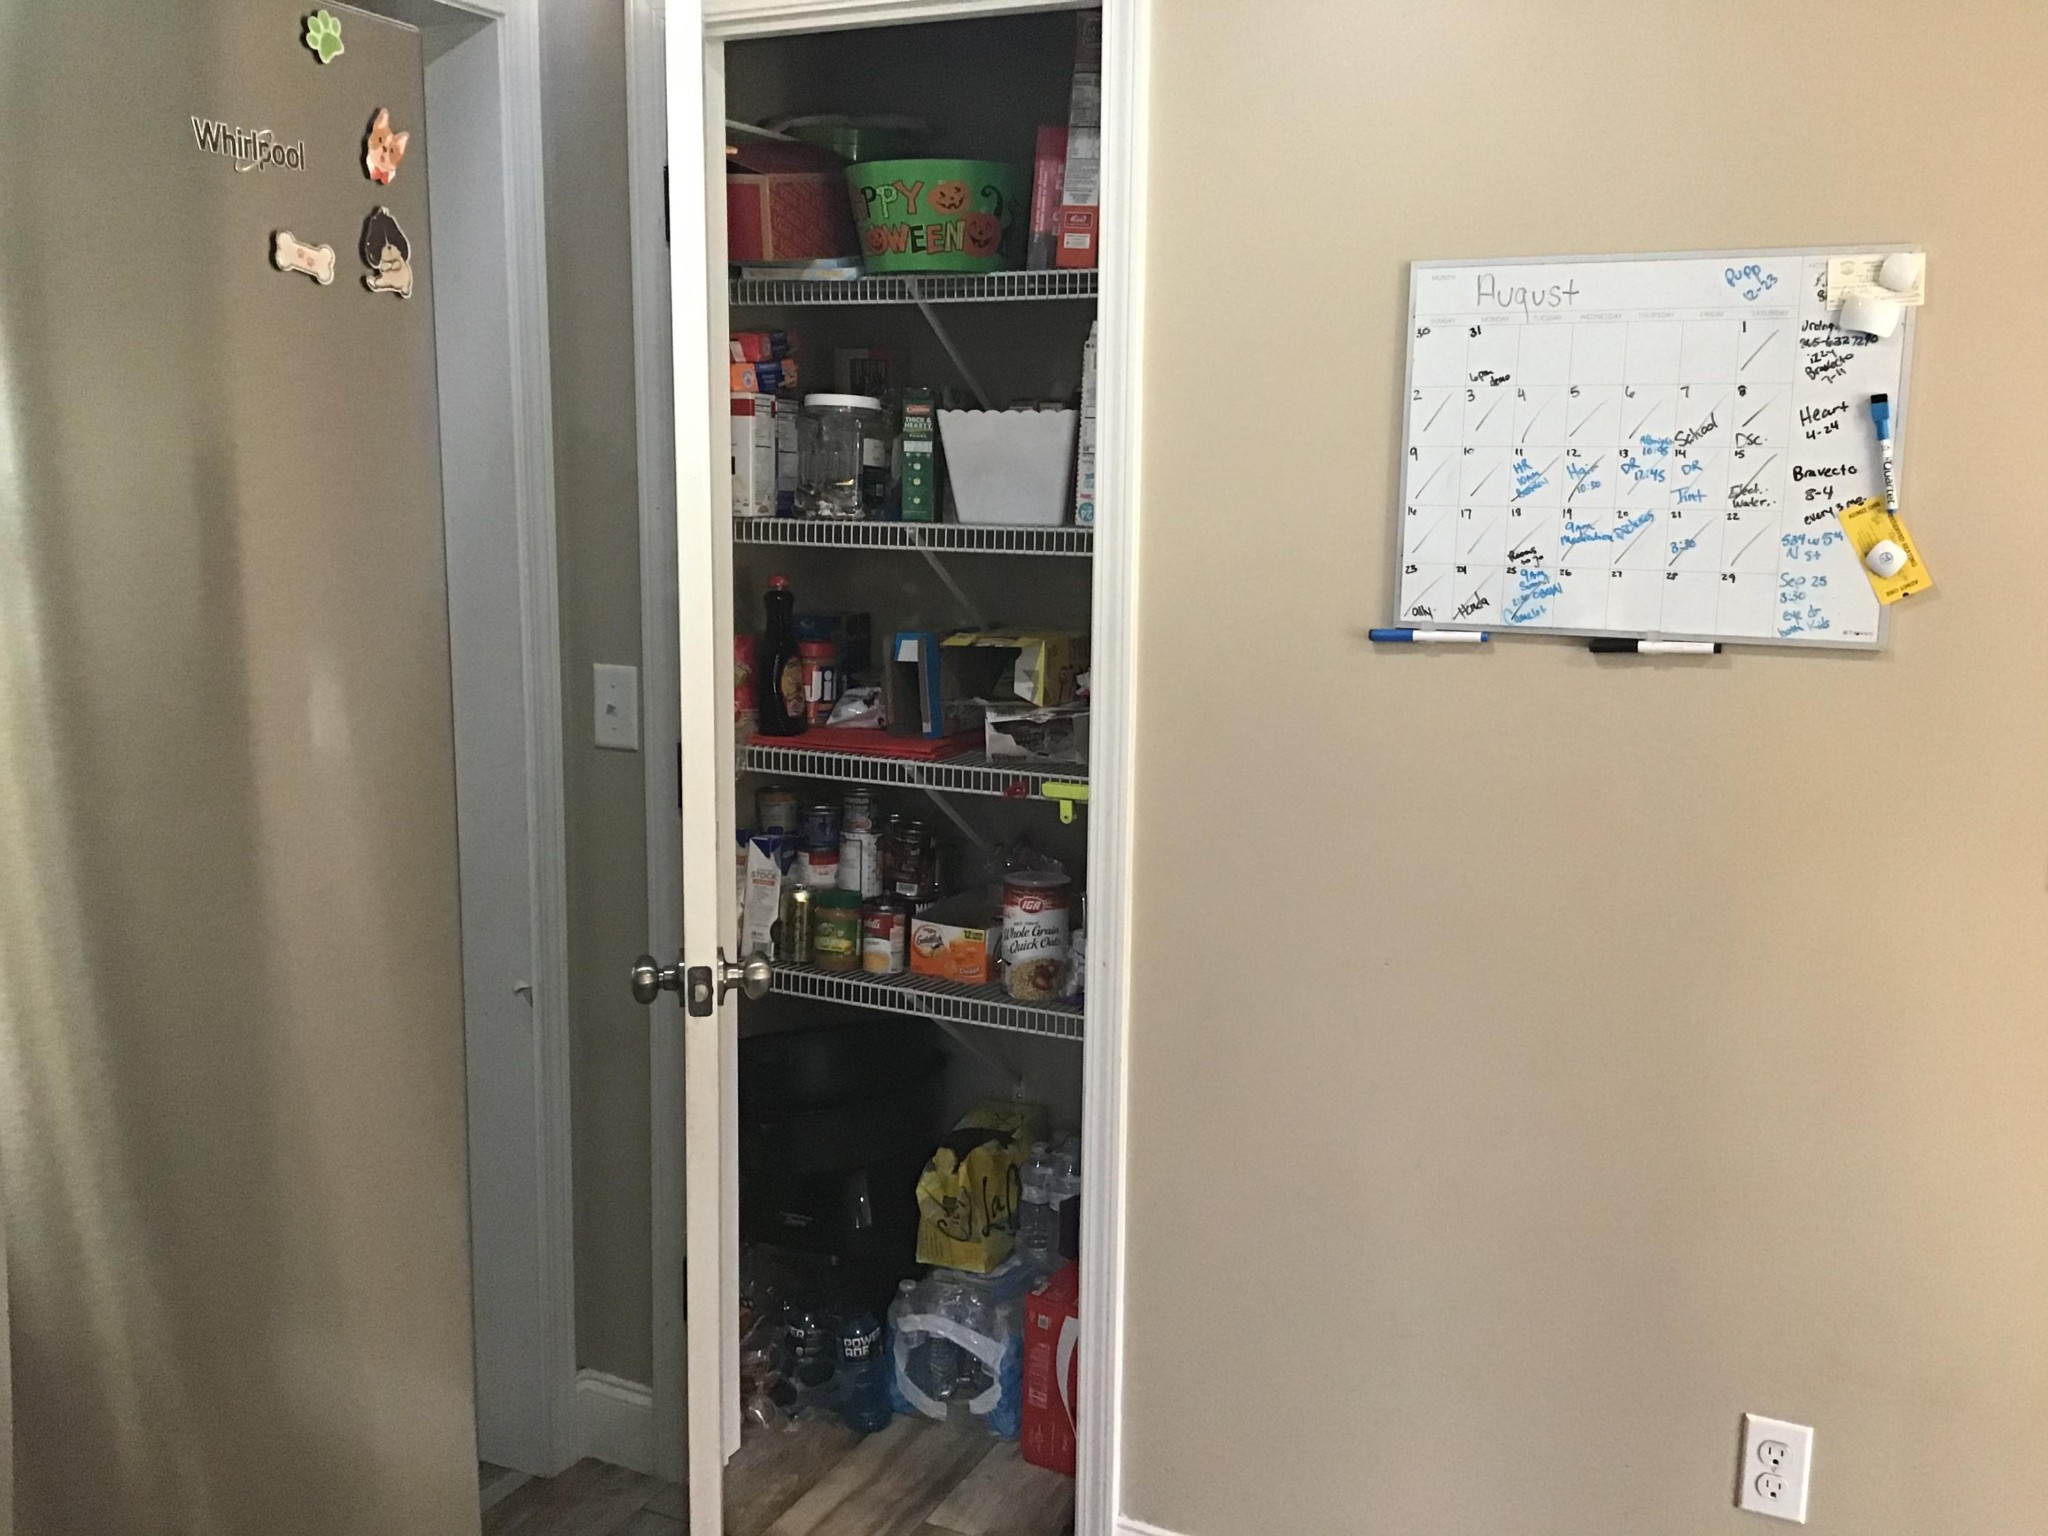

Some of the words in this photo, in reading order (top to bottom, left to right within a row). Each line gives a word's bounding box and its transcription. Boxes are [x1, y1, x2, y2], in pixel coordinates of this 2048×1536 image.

[191, 116, 306, 172] Whirlpool
[853, 180, 925, 219] PPY
[1477, 273, 1580, 324] August
[1416, 327, 1431, 338] 30
[1469, 325, 1482, 338] 31
[1742, 320, 1747, 333] 1
[1413, 389, 1422, 401] 2
[1467, 389, 1476, 402] 3
[1517, 388, 1527, 402] 4
[1569, 385, 1580, 398] 5
[1624, 384, 1636, 398] 6
[1680, 386, 1690, 398] 7
[1737, 385, 1747, 397] 8
[1800, 401, 1849, 427] Heart
[904, 422, 932, 430] HEARTY
[1674, 411, 1718, 447] School
[1410, 447, 1419, 461] 9
[1515, 448, 1524, 457] 11
[1566, 448, 1582, 457] 12
[1619, 448, 1629, 458] 13
[1675, 448, 1687, 459] 14
[1734, 449, 1745, 459] 15
[1793, 464, 1858, 482] Bravecto
[1883, 460, 1896, 505] Quartet
[1805, 485, 1834, 501] 8-4
[1461, 508, 1472, 519] 17
[1511, 508, 1522, 517] 18
[1562, 508, 1573, 520] 19
[1616, 510, 1629, 519] 20
[1671, 511, 1682, 519] 21
[1726, 513, 1740, 521] 22
[1405, 564, 1418, 574] 23
[1506, 566, 1517, 575] 25
[1559, 569, 1573, 577] 26
[1666, 572, 1678, 580] 28
[1721, 573, 1736, 584] 29
[1811, 575, 1828, 588] 25
[1021, 900, 1042, 911] IGA
[916, 932, 944, 946] Goldfish
[1004, 926, 1030, 942] Whole
[1032, 925, 1059, 937] Grain
[1009, 939, 1038, 954] Quick
